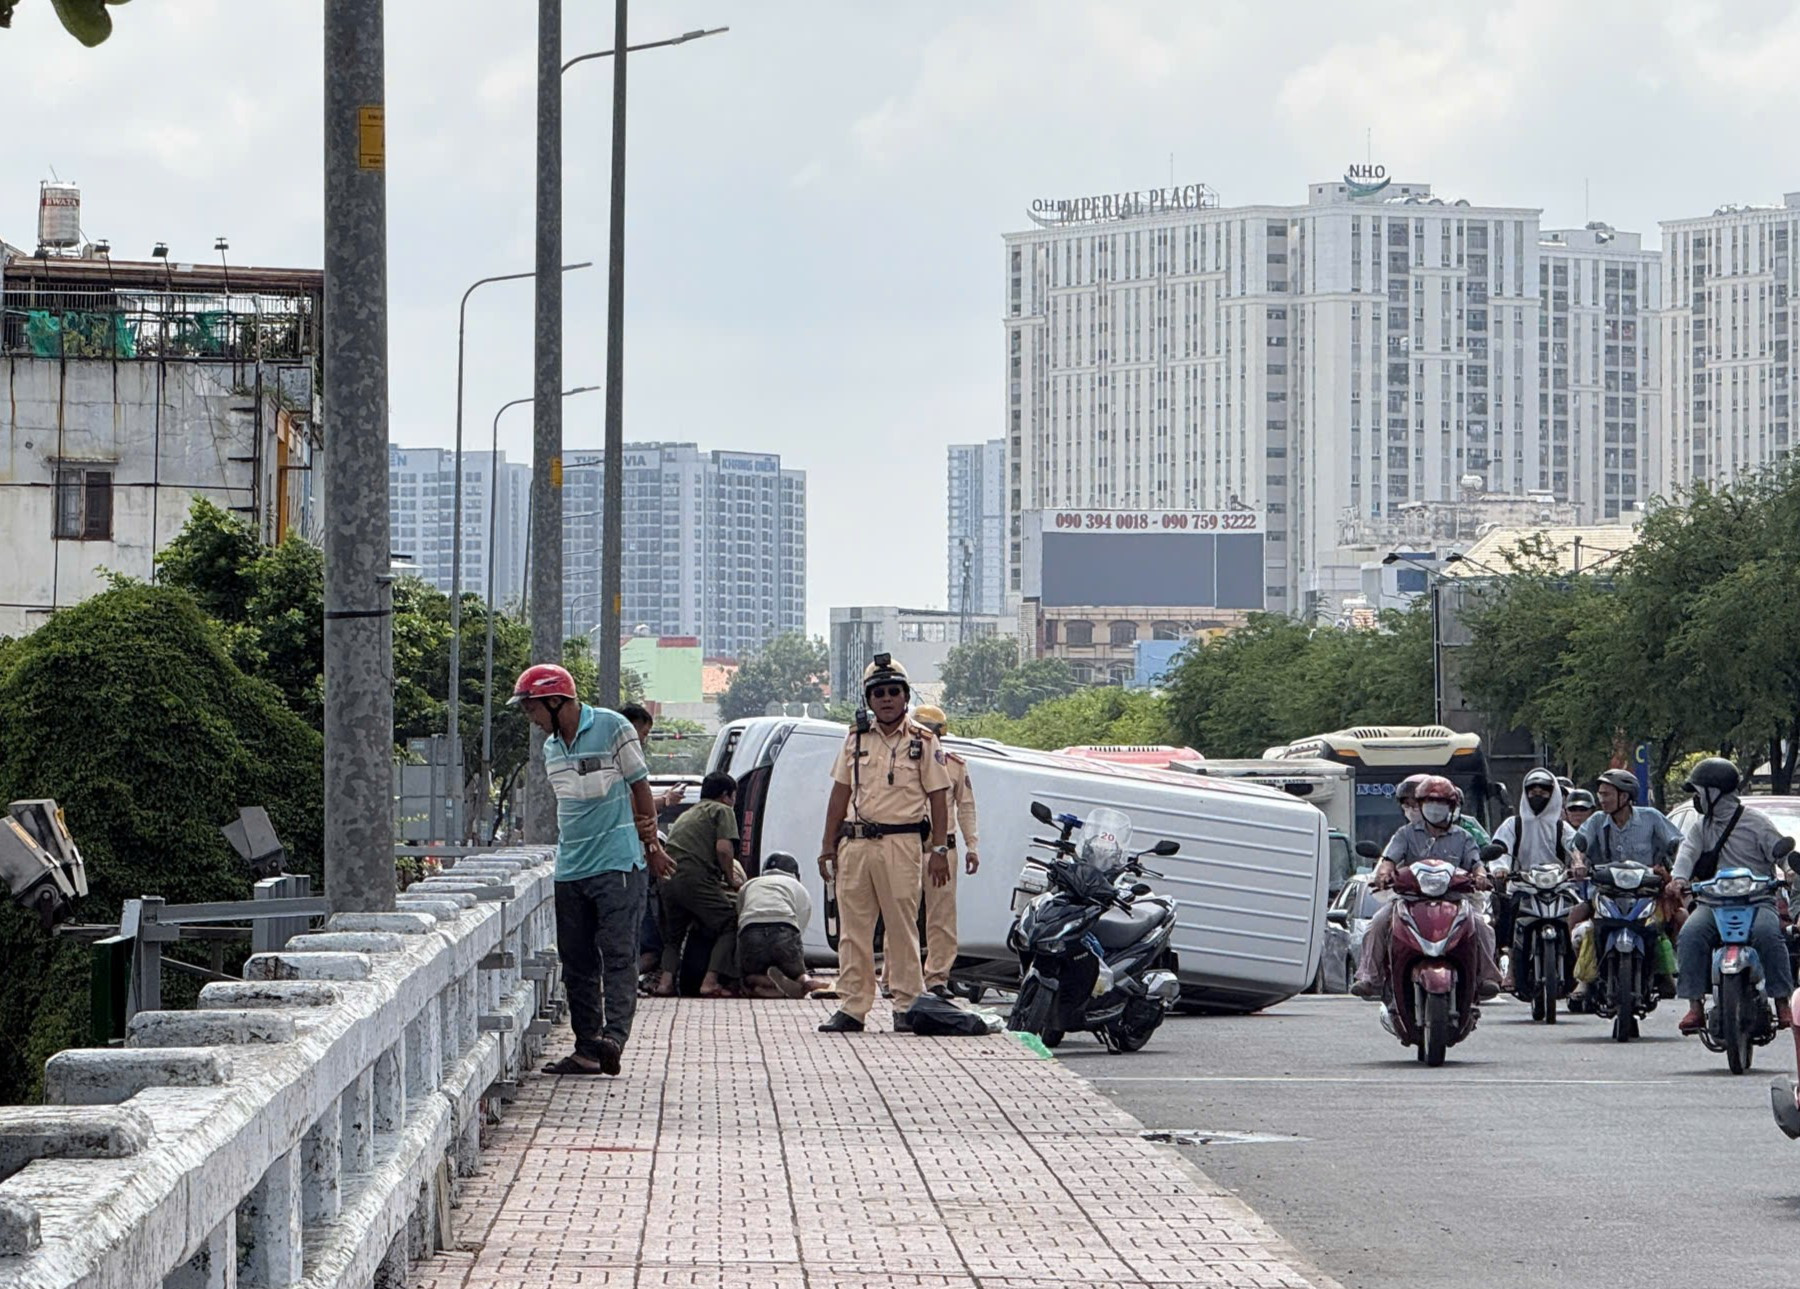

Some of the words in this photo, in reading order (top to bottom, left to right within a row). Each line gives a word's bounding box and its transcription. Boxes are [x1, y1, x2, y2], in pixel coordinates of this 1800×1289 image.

[1060, 191, 1144, 223] IMPERIAL
[1149, 183, 1206, 213] PLACE
[1055, 513, 1082, 529] 090
[1085, 513, 1112, 529] 394
[1115, 513, 1149, 530] 0018
[1162, 514, 1188, 529] 090
[1191, 514, 1218, 530] 759
[1221, 514, 1257, 530] 3222
[1356, 783, 1397, 799] NGỌ
[1100, 831, 1115, 842] 20
